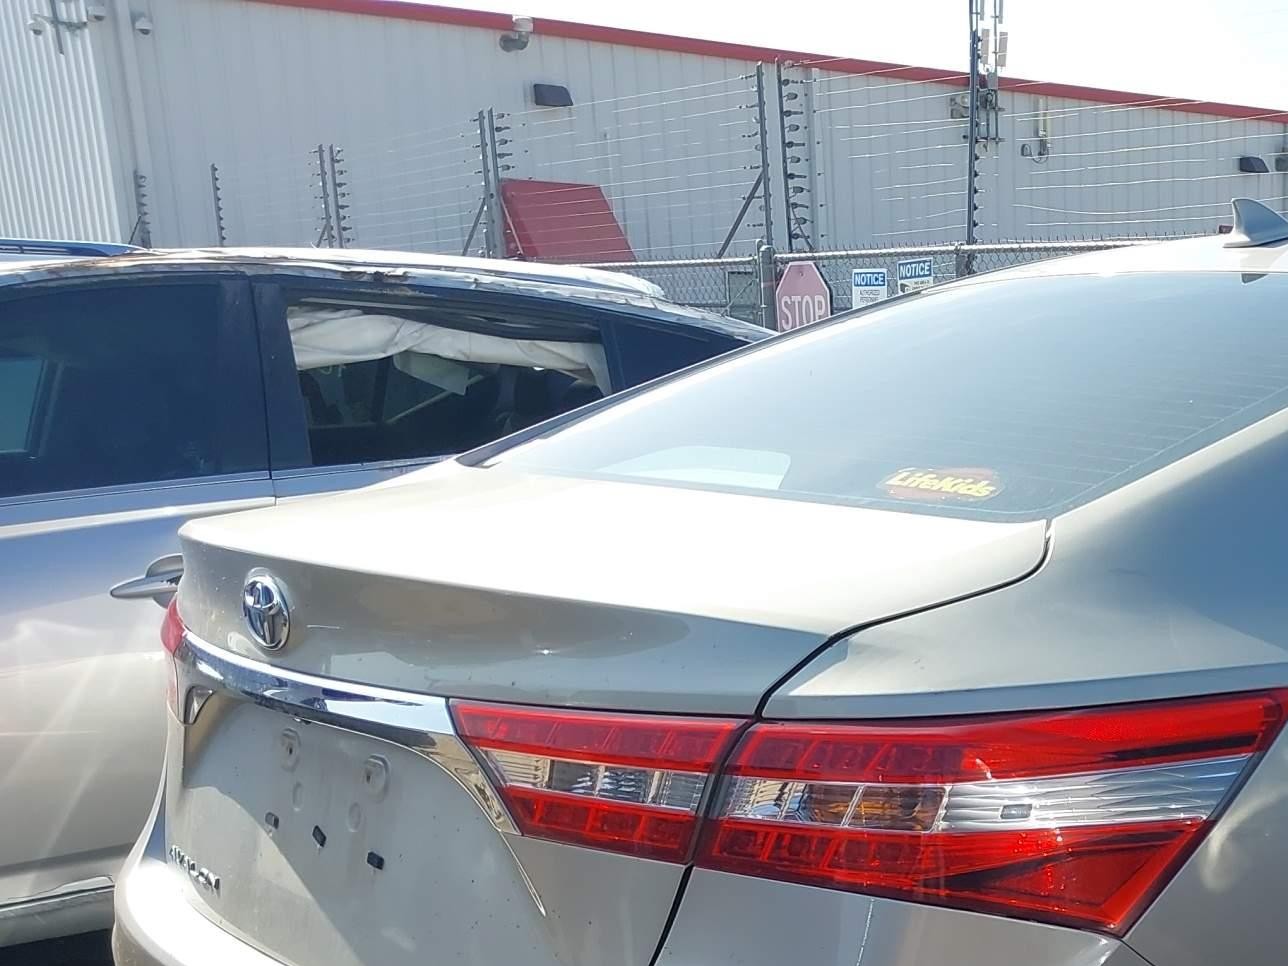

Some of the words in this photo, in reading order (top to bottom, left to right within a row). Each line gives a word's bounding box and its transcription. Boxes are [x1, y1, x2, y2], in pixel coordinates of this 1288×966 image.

[854, 273, 885, 286] NOTICE
[899, 262, 930, 278] NOTICE
[780, 295, 826, 331] STOP
[885, 471, 997, 497] LifeKids
